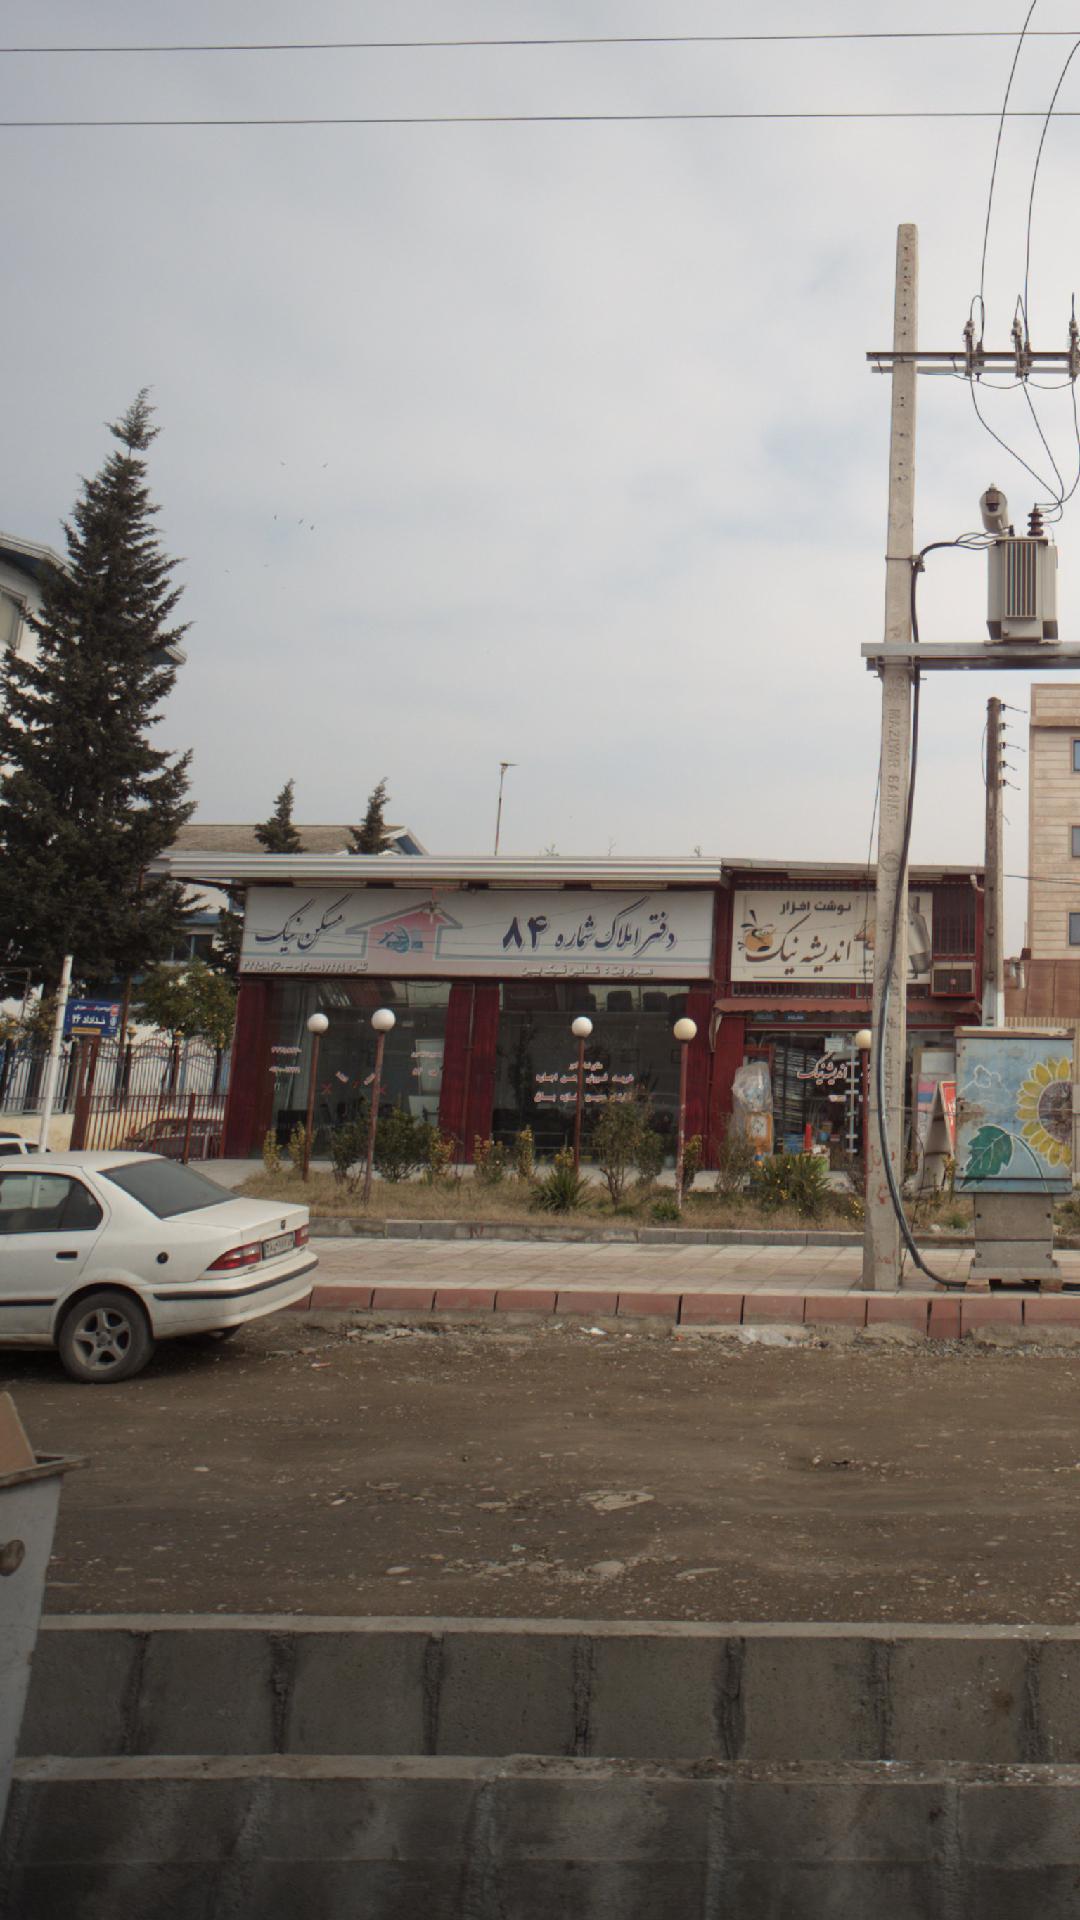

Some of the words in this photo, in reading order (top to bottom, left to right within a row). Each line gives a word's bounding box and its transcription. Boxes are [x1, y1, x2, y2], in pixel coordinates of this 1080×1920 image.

[255, 898, 315, 953] نیک
[297, 893, 353, 951] مسکن
[594, 895, 648, 949] املاک
[779, 901, 810, 915] افزار
[814, 901, 851, 915] نوشت
[502, 915, 547, 949] ۸۴
[555, 914, 594, 948] شماره
[632, 911, 676, 956] دفتر
[745, 913, 812, 975] نیک
[801, 936, 850, 973] اندیشه
